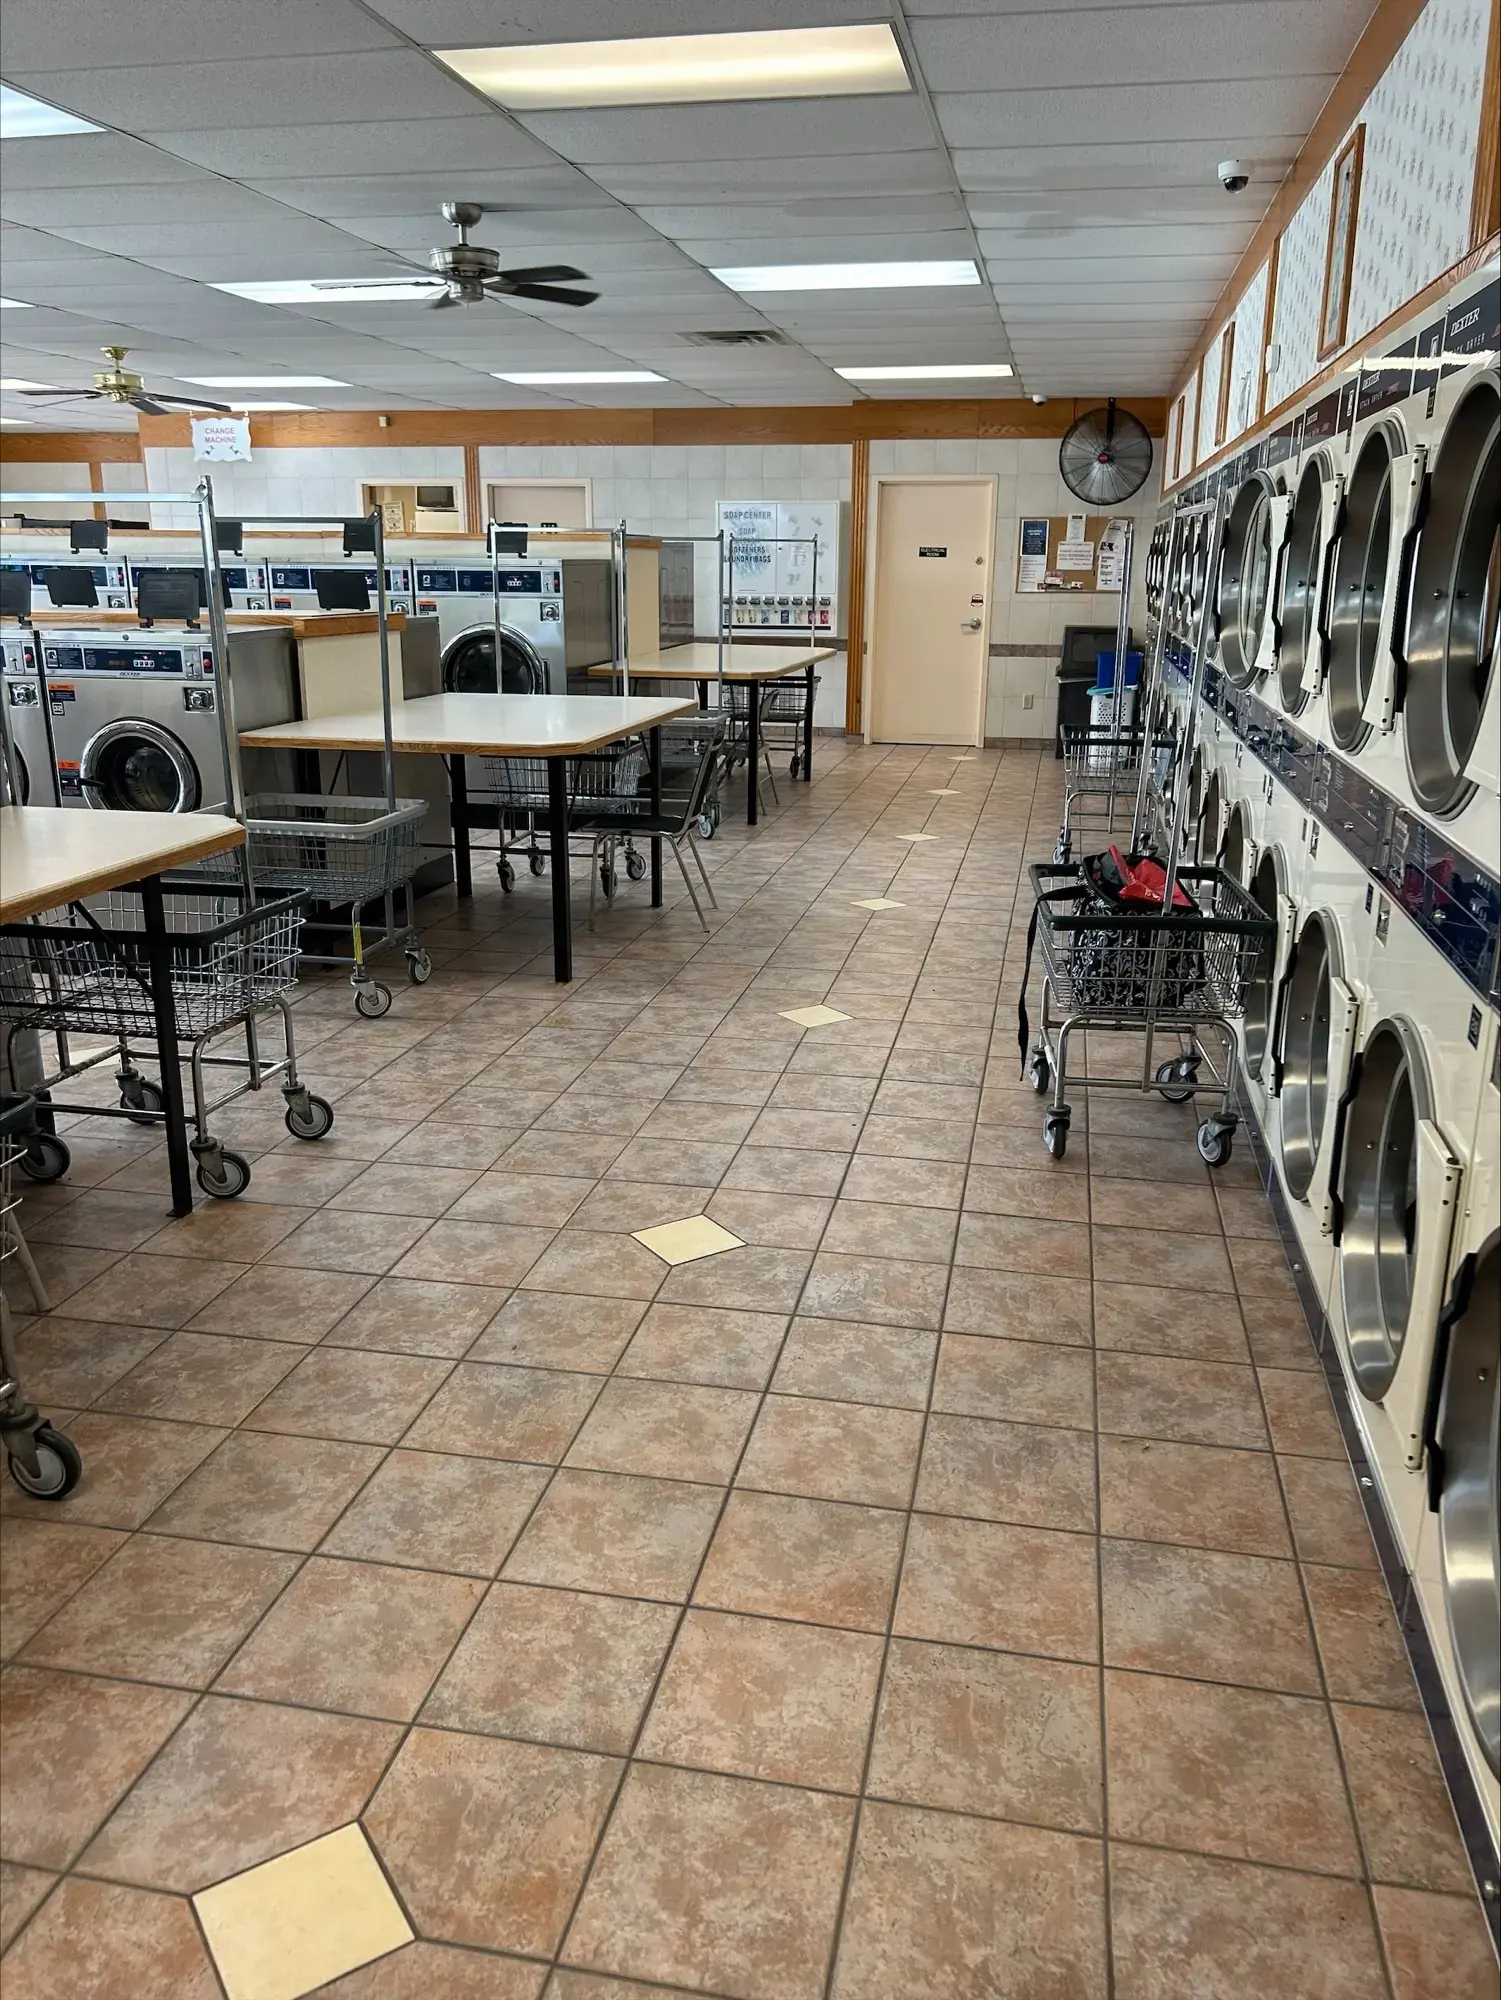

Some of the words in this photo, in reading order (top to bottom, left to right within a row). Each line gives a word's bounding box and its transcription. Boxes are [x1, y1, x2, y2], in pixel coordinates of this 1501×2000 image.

[1450, 307, 1480, 336] DEXTER
[204, 427, 235, 435] CHANGE
[723, 511, 743, 519] SOAP
[744, 511, 772, 519] CENTER
[739, 527, 756, 535] SOAP
[731, 546, 766, 554] OFTENERS
[754, 555, 772, 563] BAGS
